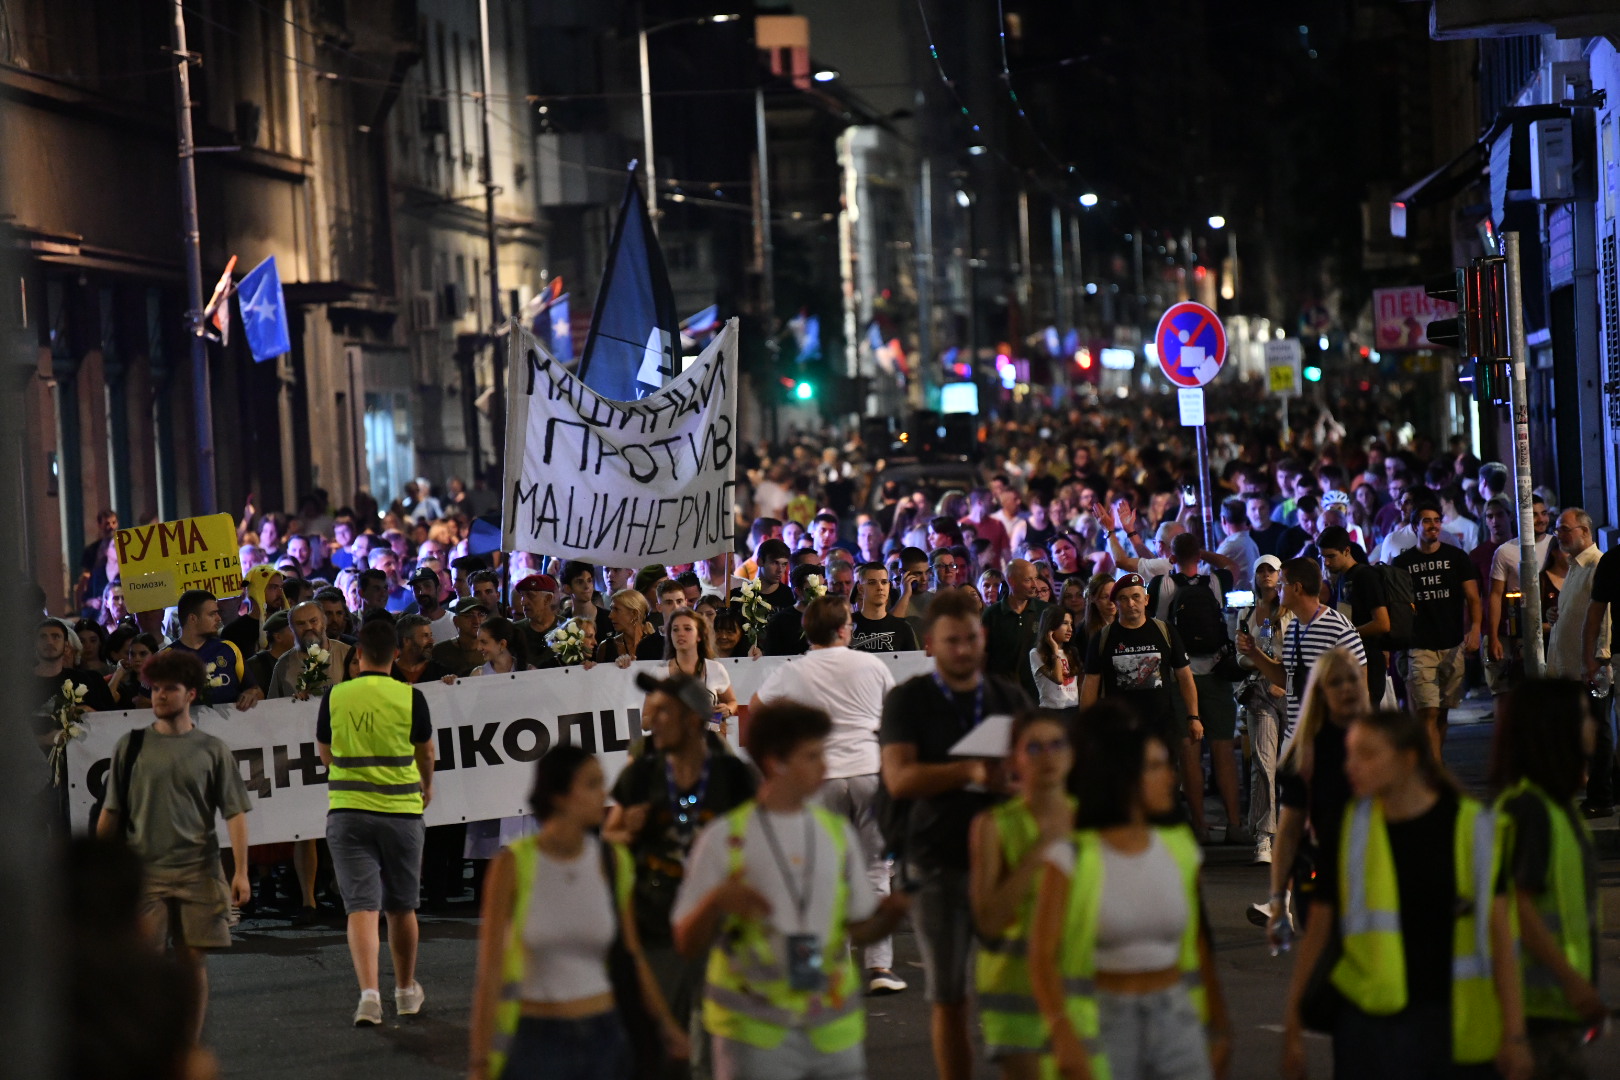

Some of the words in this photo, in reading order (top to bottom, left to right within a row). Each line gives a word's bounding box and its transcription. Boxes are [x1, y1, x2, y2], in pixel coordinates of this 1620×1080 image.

[543, 415, 733, 484] ПРОТИВ
[510, 480, 735, 556] МАШИНЕРИЈЕ
[116, 519, 208, 565] РУМА
[184, 560, 207, 575] ГДЕ
[1408, 560, 1451, 574] IGNORE
[1420, 575, 1442, 586] THE
[856, 632, 894, 651] AIR
[349, 711, 375, 733] VII
